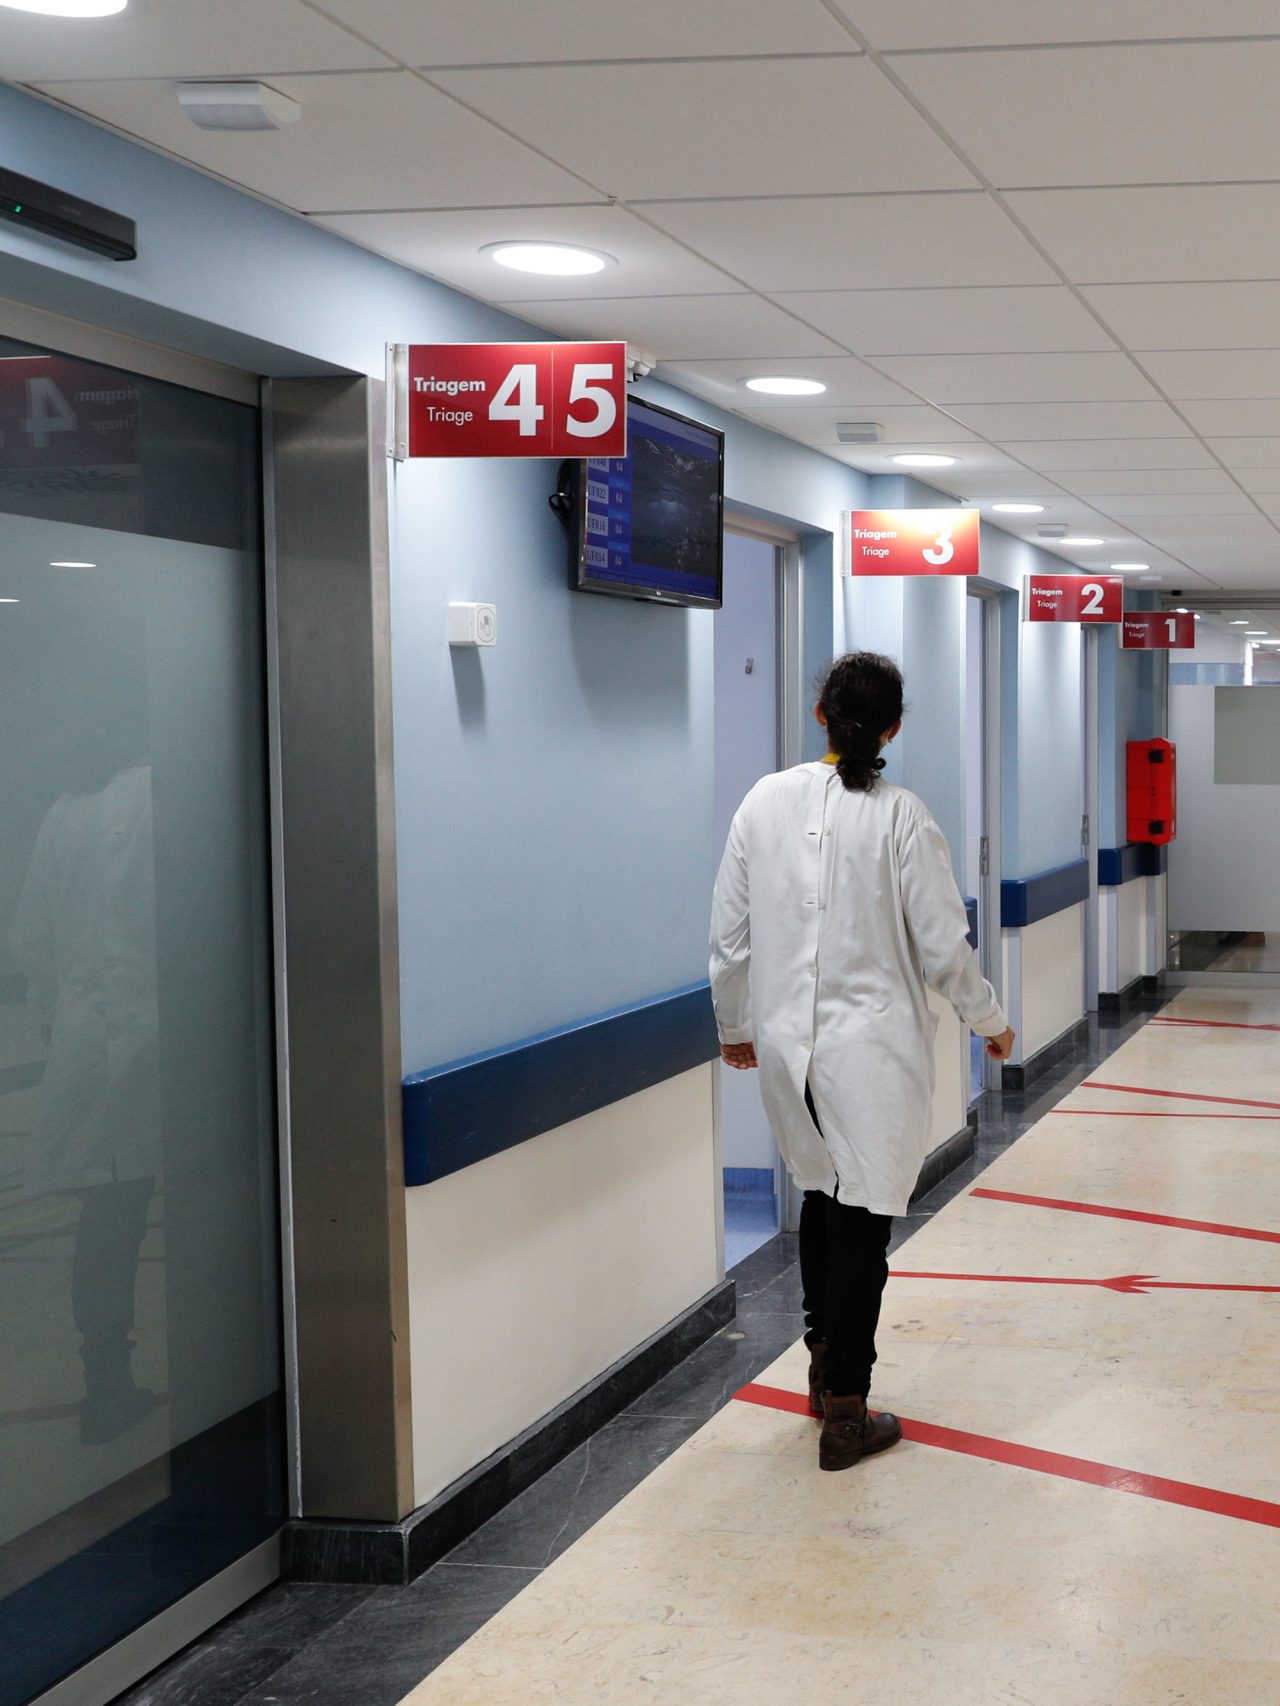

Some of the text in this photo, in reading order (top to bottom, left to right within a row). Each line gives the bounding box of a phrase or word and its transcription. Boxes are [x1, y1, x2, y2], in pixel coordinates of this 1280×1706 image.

[413, 375, 486, 397] Triagem
[488, 363, 617, 438] 4 5
[426, 406, 474, 426] Triage
[853, 521, 955, 566] Triagem 3
[861, 546, 890, 559] Triage
[1032, 583, 1105, 615] Triagem 2
[1036, 600, 1058, 610] Triage
[1124, 618, 1177, 642] Triagem 1
[1128, 631, 1145, 639] Triage
